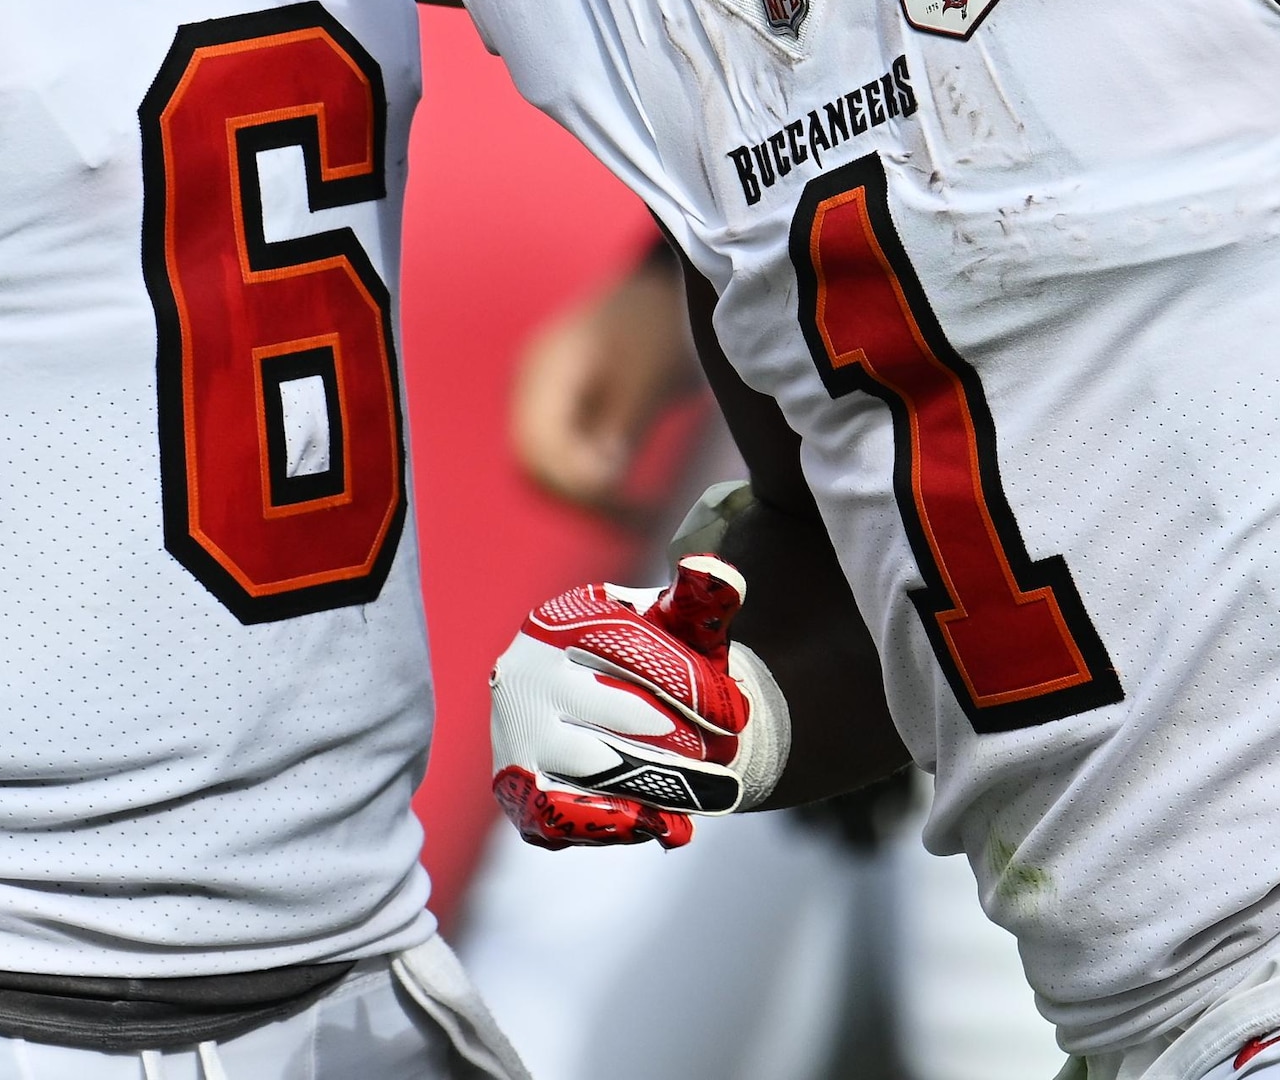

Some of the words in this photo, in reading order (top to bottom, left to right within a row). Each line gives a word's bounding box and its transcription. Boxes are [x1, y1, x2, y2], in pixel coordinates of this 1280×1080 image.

[137, 0, 408, 626] 6
[726, 54, 918, 206] BUCCANEERS
[788, 150, 1125, 734] 1
